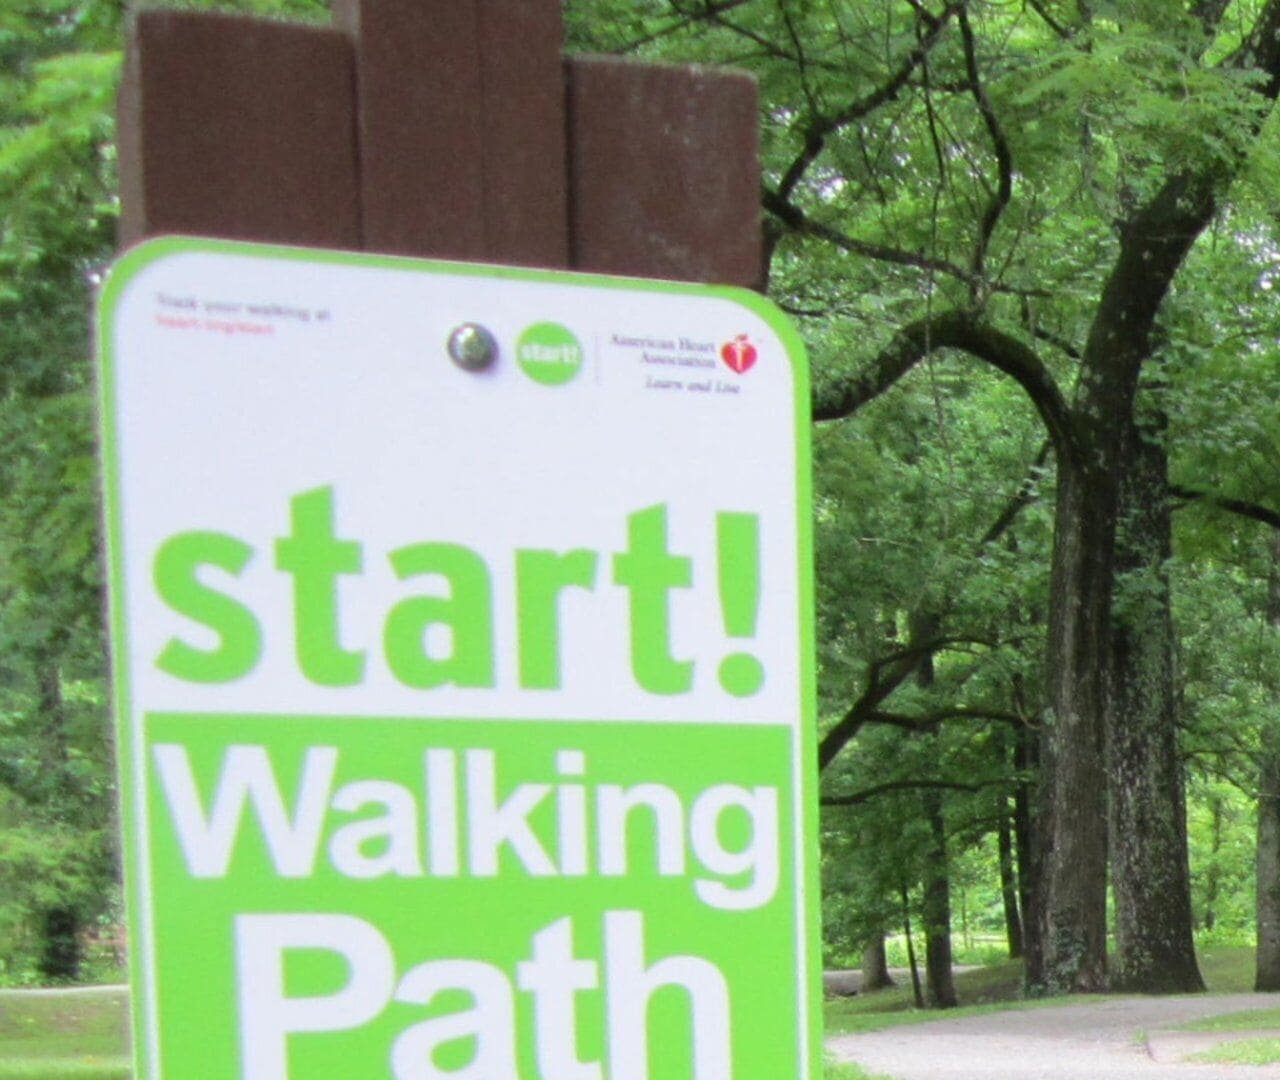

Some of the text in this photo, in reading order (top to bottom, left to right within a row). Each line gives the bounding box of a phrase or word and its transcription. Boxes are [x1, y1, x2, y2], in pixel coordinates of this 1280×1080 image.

[612, 333, 716, 352] American Heart
[521, 343, 580, 364] start!
[640, 351, 716, 369] Association
[645, 376, 683, 390] Learn
[688, 379, 711, 393] and
[153, 484, 766, 698] start!
[152, 742, 780, 911] Walking
